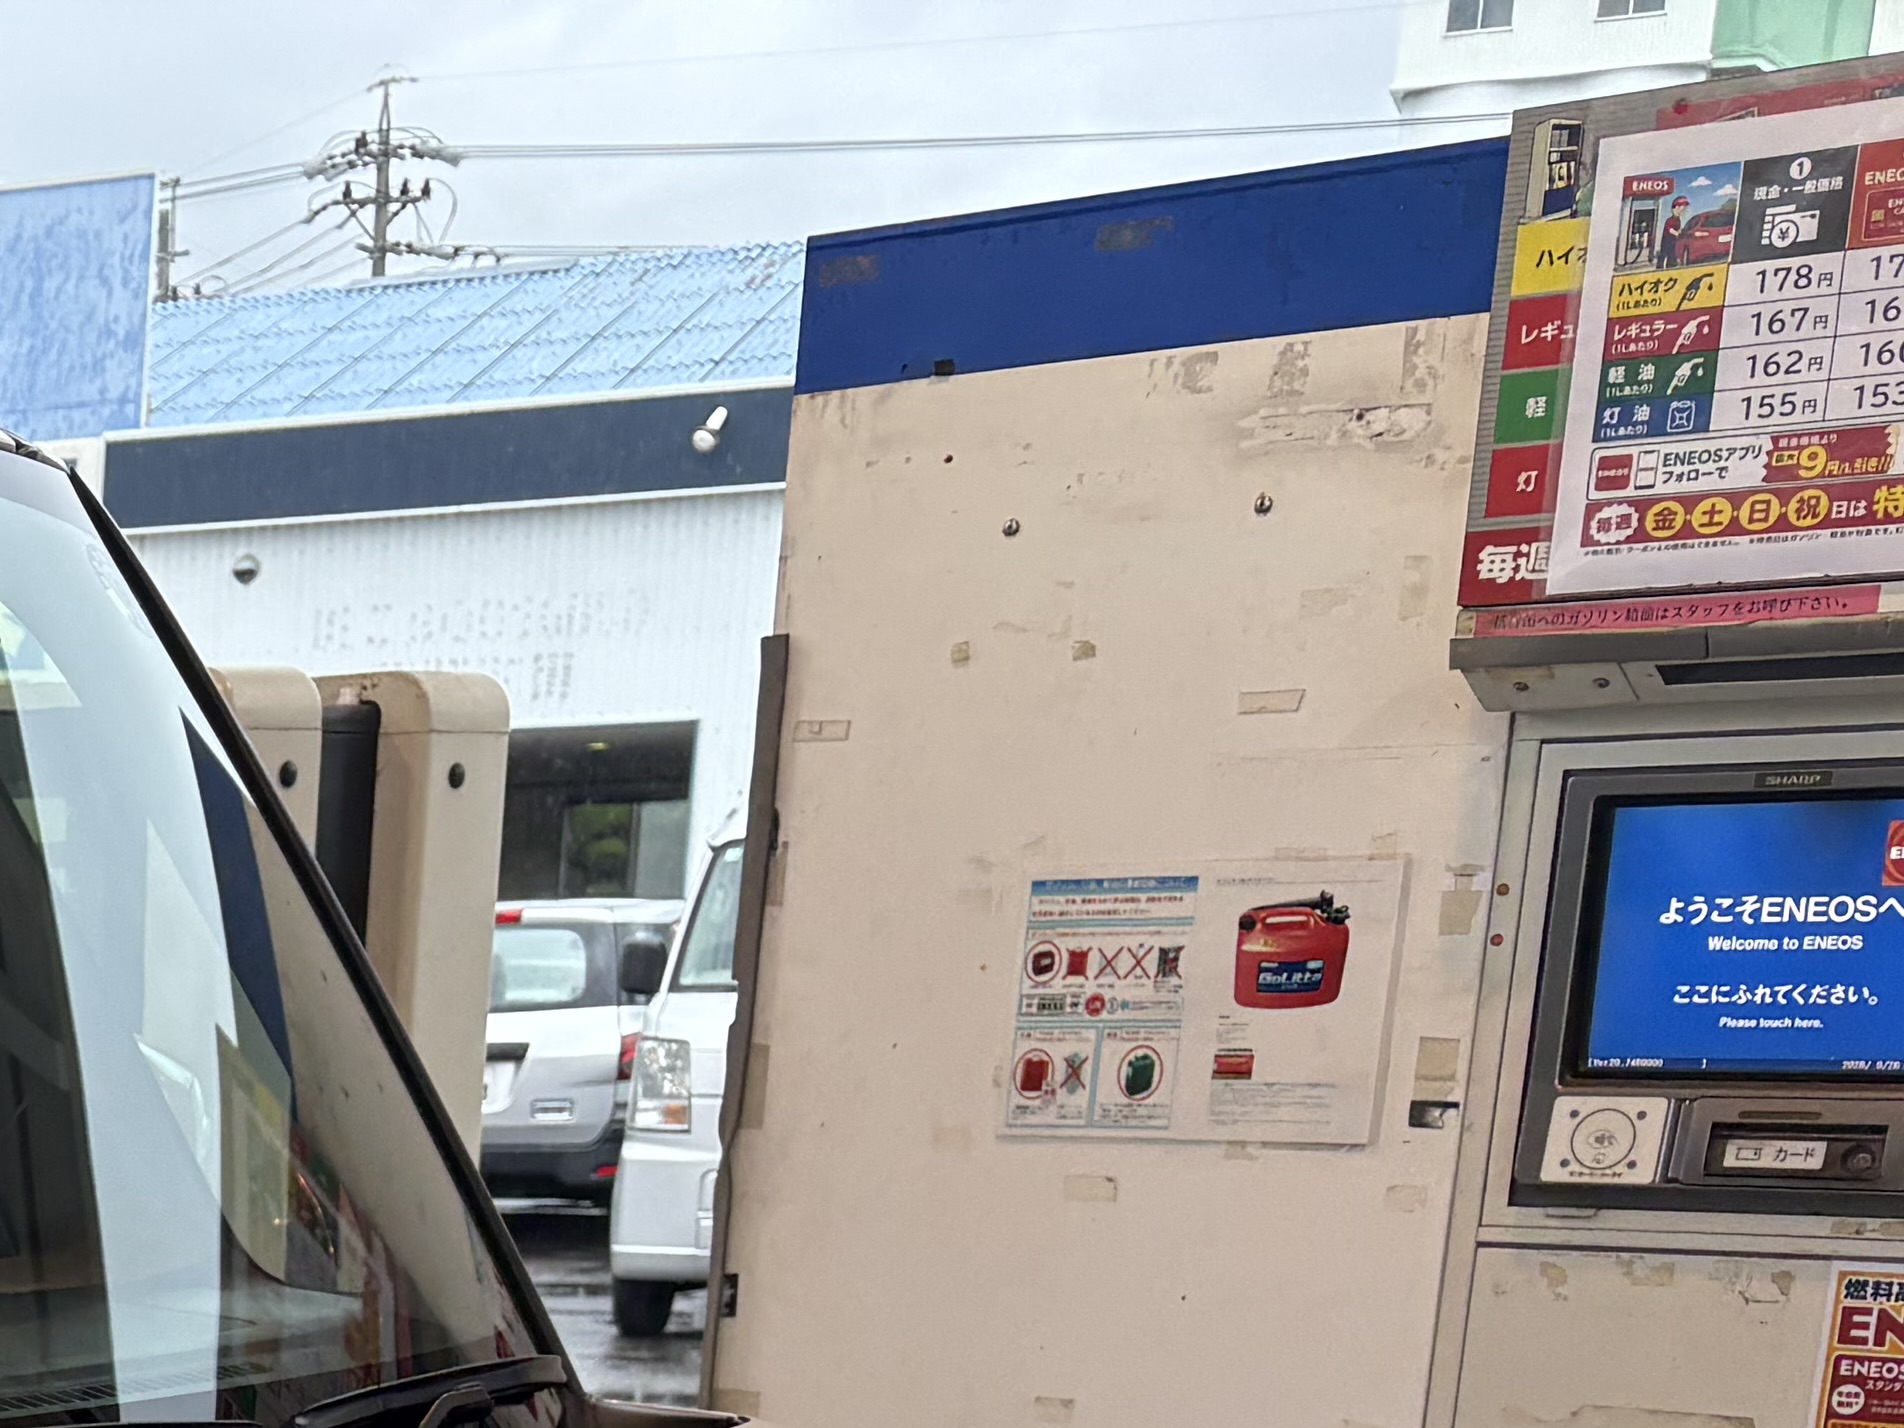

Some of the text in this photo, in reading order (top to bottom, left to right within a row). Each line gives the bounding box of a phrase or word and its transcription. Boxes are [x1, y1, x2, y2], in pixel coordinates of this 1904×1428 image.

[1632, 179, 1670, 192] ENEOS
[1619, 277, 1678, 297] ハイオク
[1756, 264, 1834, 295] 178円
[1614, 319, 1678, 340] レギュラー
[1750, 307, 1829, 337] 167円
[1746, 350, 1823, 379] 162円
[1741, 392, 1817, 421] 155円
[1662, 444, 1763, 468] ENEOSアプリ
[1661, 466, 1729, 484] フォローで
[1765, 774, 1821, 786] SHARP
[1659, 894, 1904, 926] ようこそENEOSへ
[1708, 935, 1864, 951] Welcome to ENEOS
[1673, 983, 1879, 1006] ここにふれてください。
[1719, 1017, 1824, 1029] Please touch here.
[1773, 1146, 1816, 1162] カード
